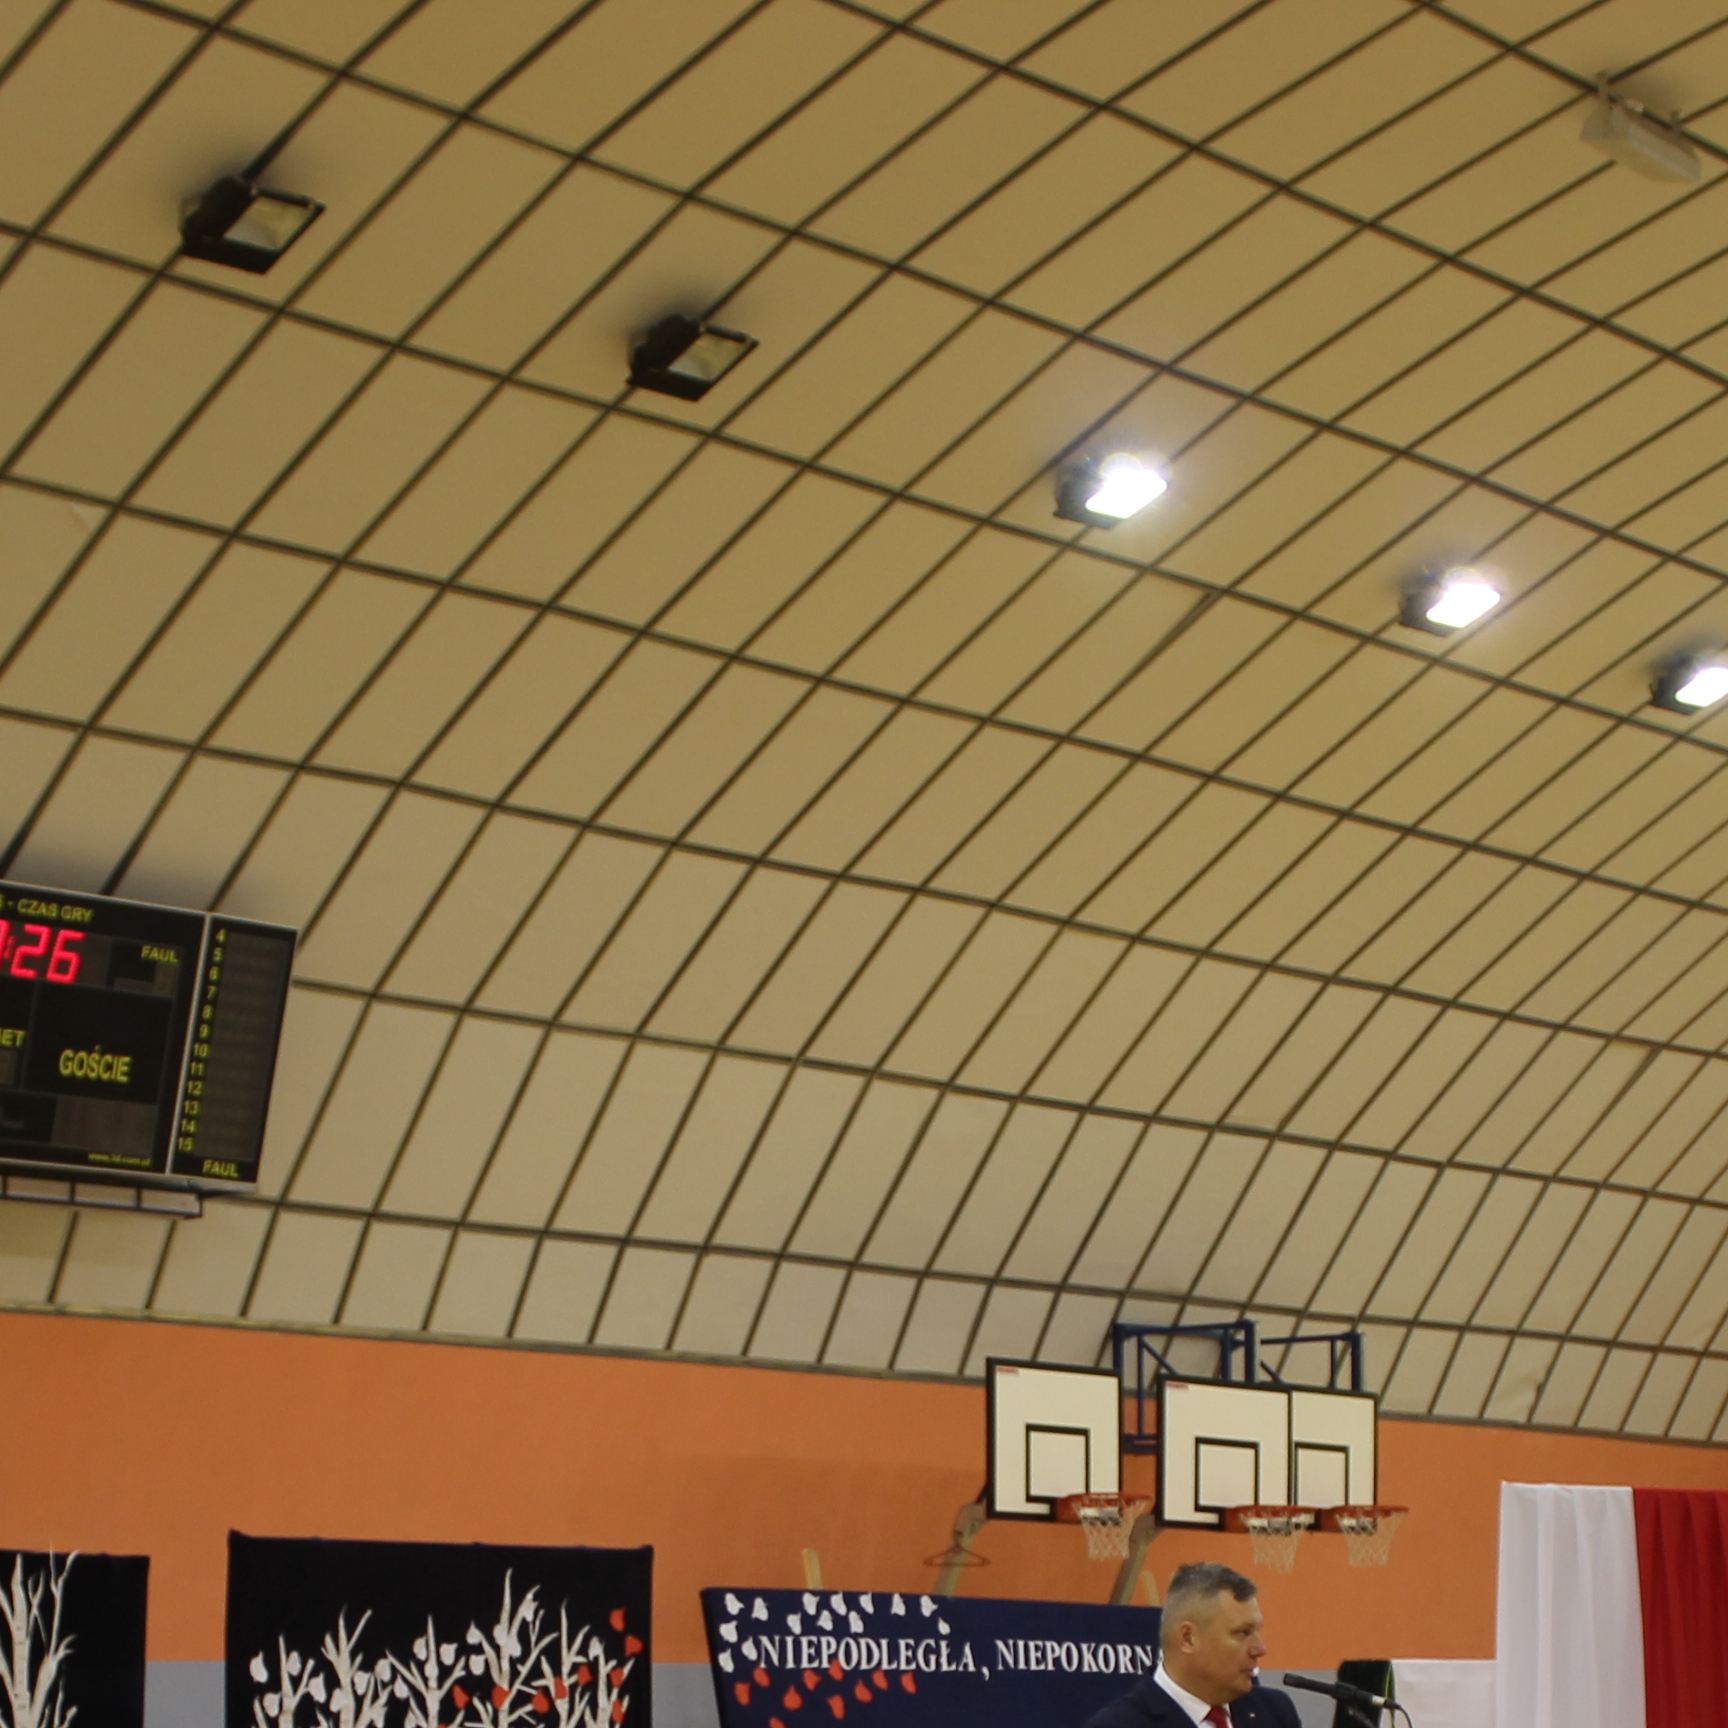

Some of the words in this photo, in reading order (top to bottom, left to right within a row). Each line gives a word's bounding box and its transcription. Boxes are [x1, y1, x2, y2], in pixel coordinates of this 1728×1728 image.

[17, 898, 59, 918] CZAS
[61, 905, 94, 923] GRY
[216, 929, 227, 943] 4
[141, 944, 179, 963] FAUL
[213, 947, 223, 962] 5
[209, 966, 220, 981] 6
[206, 985, 217, 999] 7
[202, 1004, 213, 1020] 8
[199, 1023, 210, 1039] 9
[193, 1042, 209, 1058] 10
[59, 1044, 132, 1083] GOŚCIE
[190, 1061, 205, 1076] 11
[187, 1080, 203, 1096] 12
[183, 1099, 200, 1115] 13
[180, 1118, 196, 1134] 14
[202, 1159, 239, 1178] FAUL
[758, 1633, 991, 1681] NIEPODLEGŁA,
